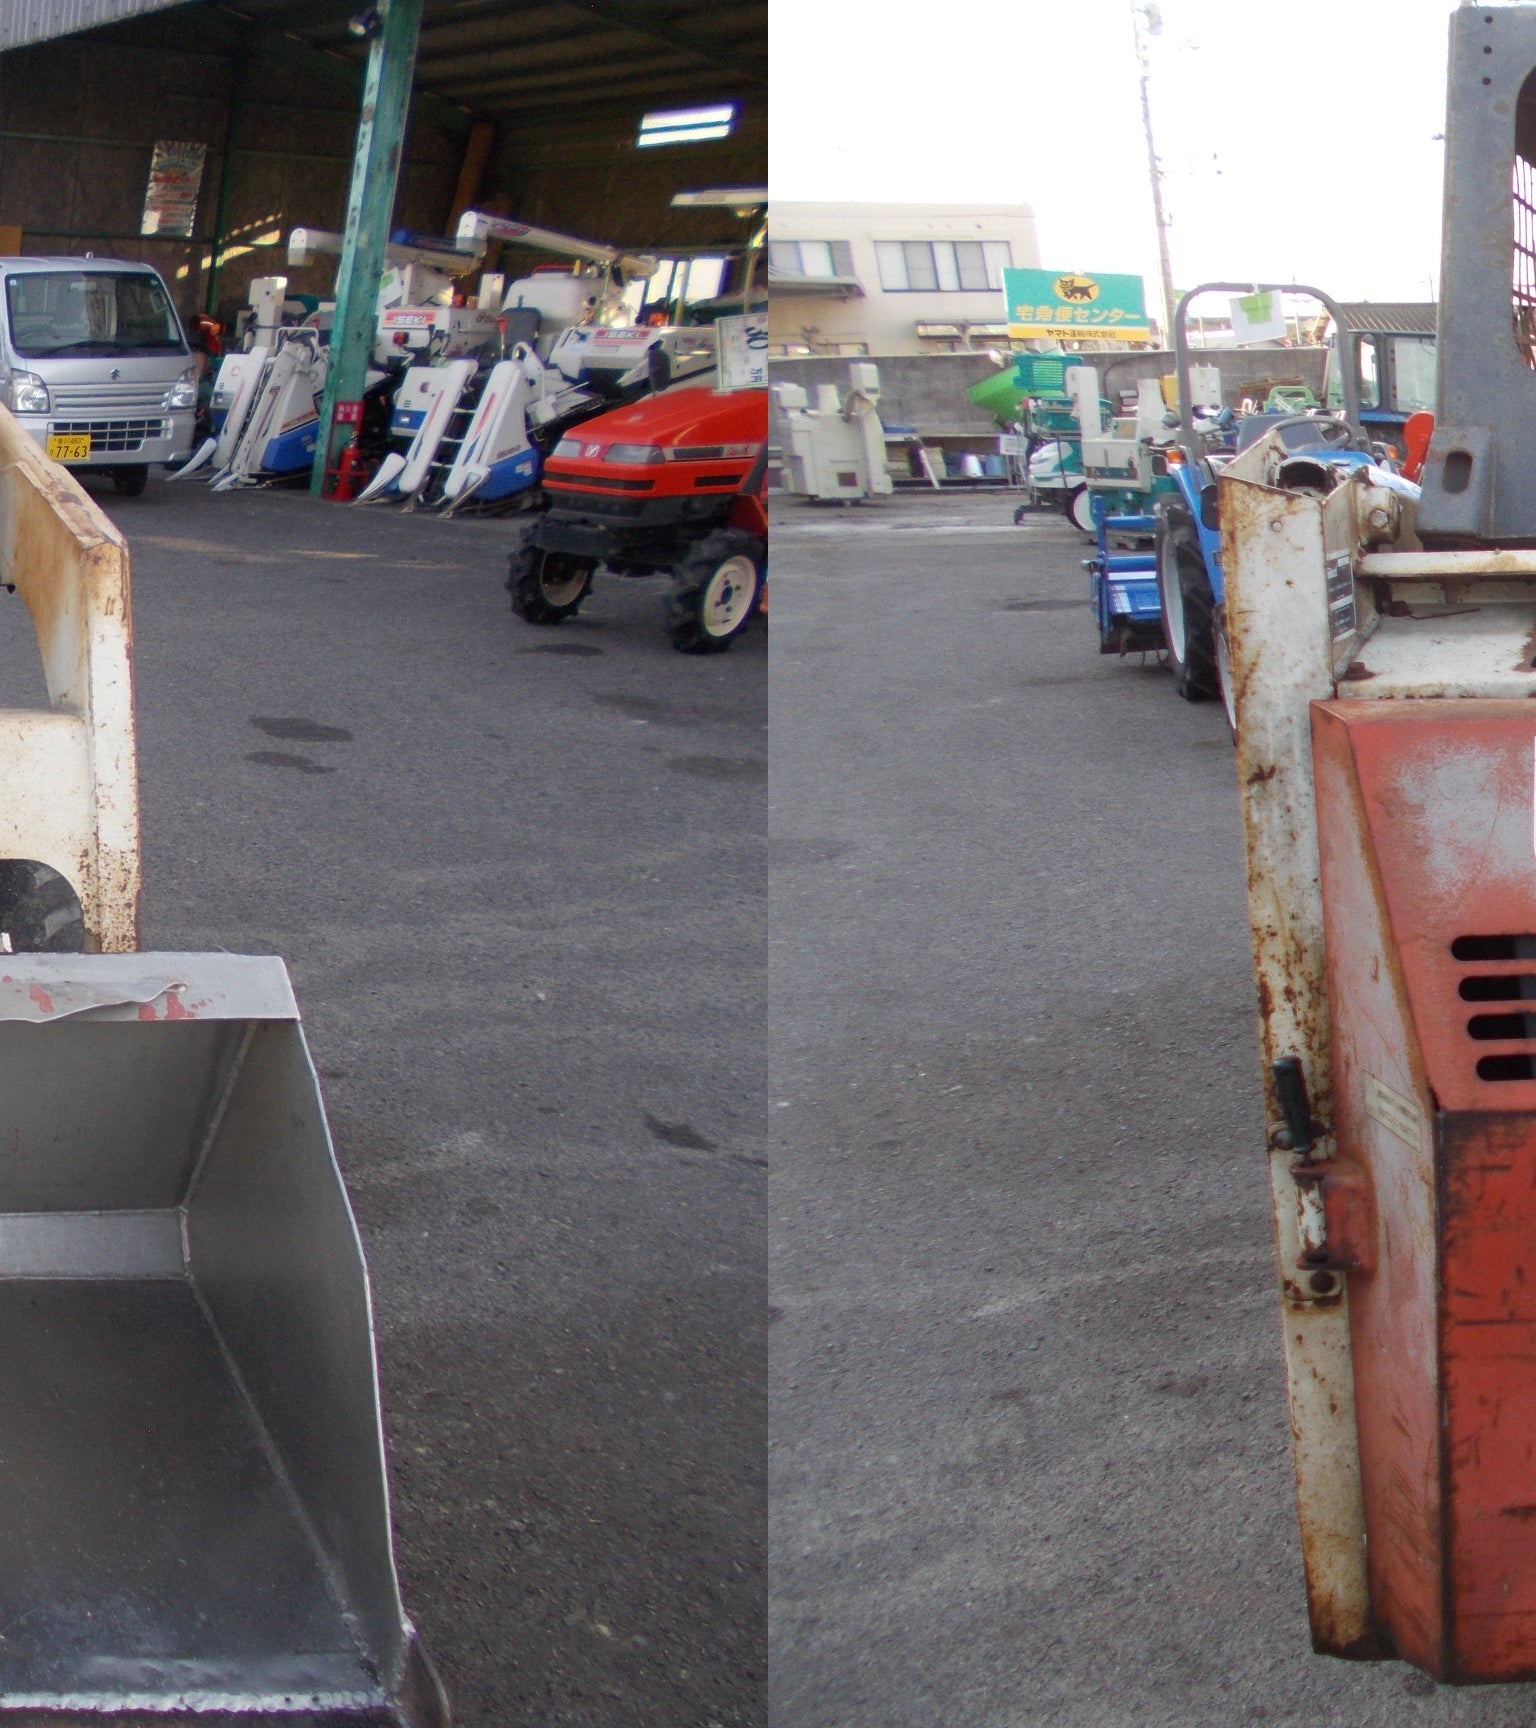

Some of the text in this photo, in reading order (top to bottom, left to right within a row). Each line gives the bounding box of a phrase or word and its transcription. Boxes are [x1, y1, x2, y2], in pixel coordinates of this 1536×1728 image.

[393, 315, 427, 325] ISEKI
[1016, 305, 1141, 324] 宅急便センター
[606, 329, 642, 340] ISEKI
[56, 445, 88, 458] 77-63
